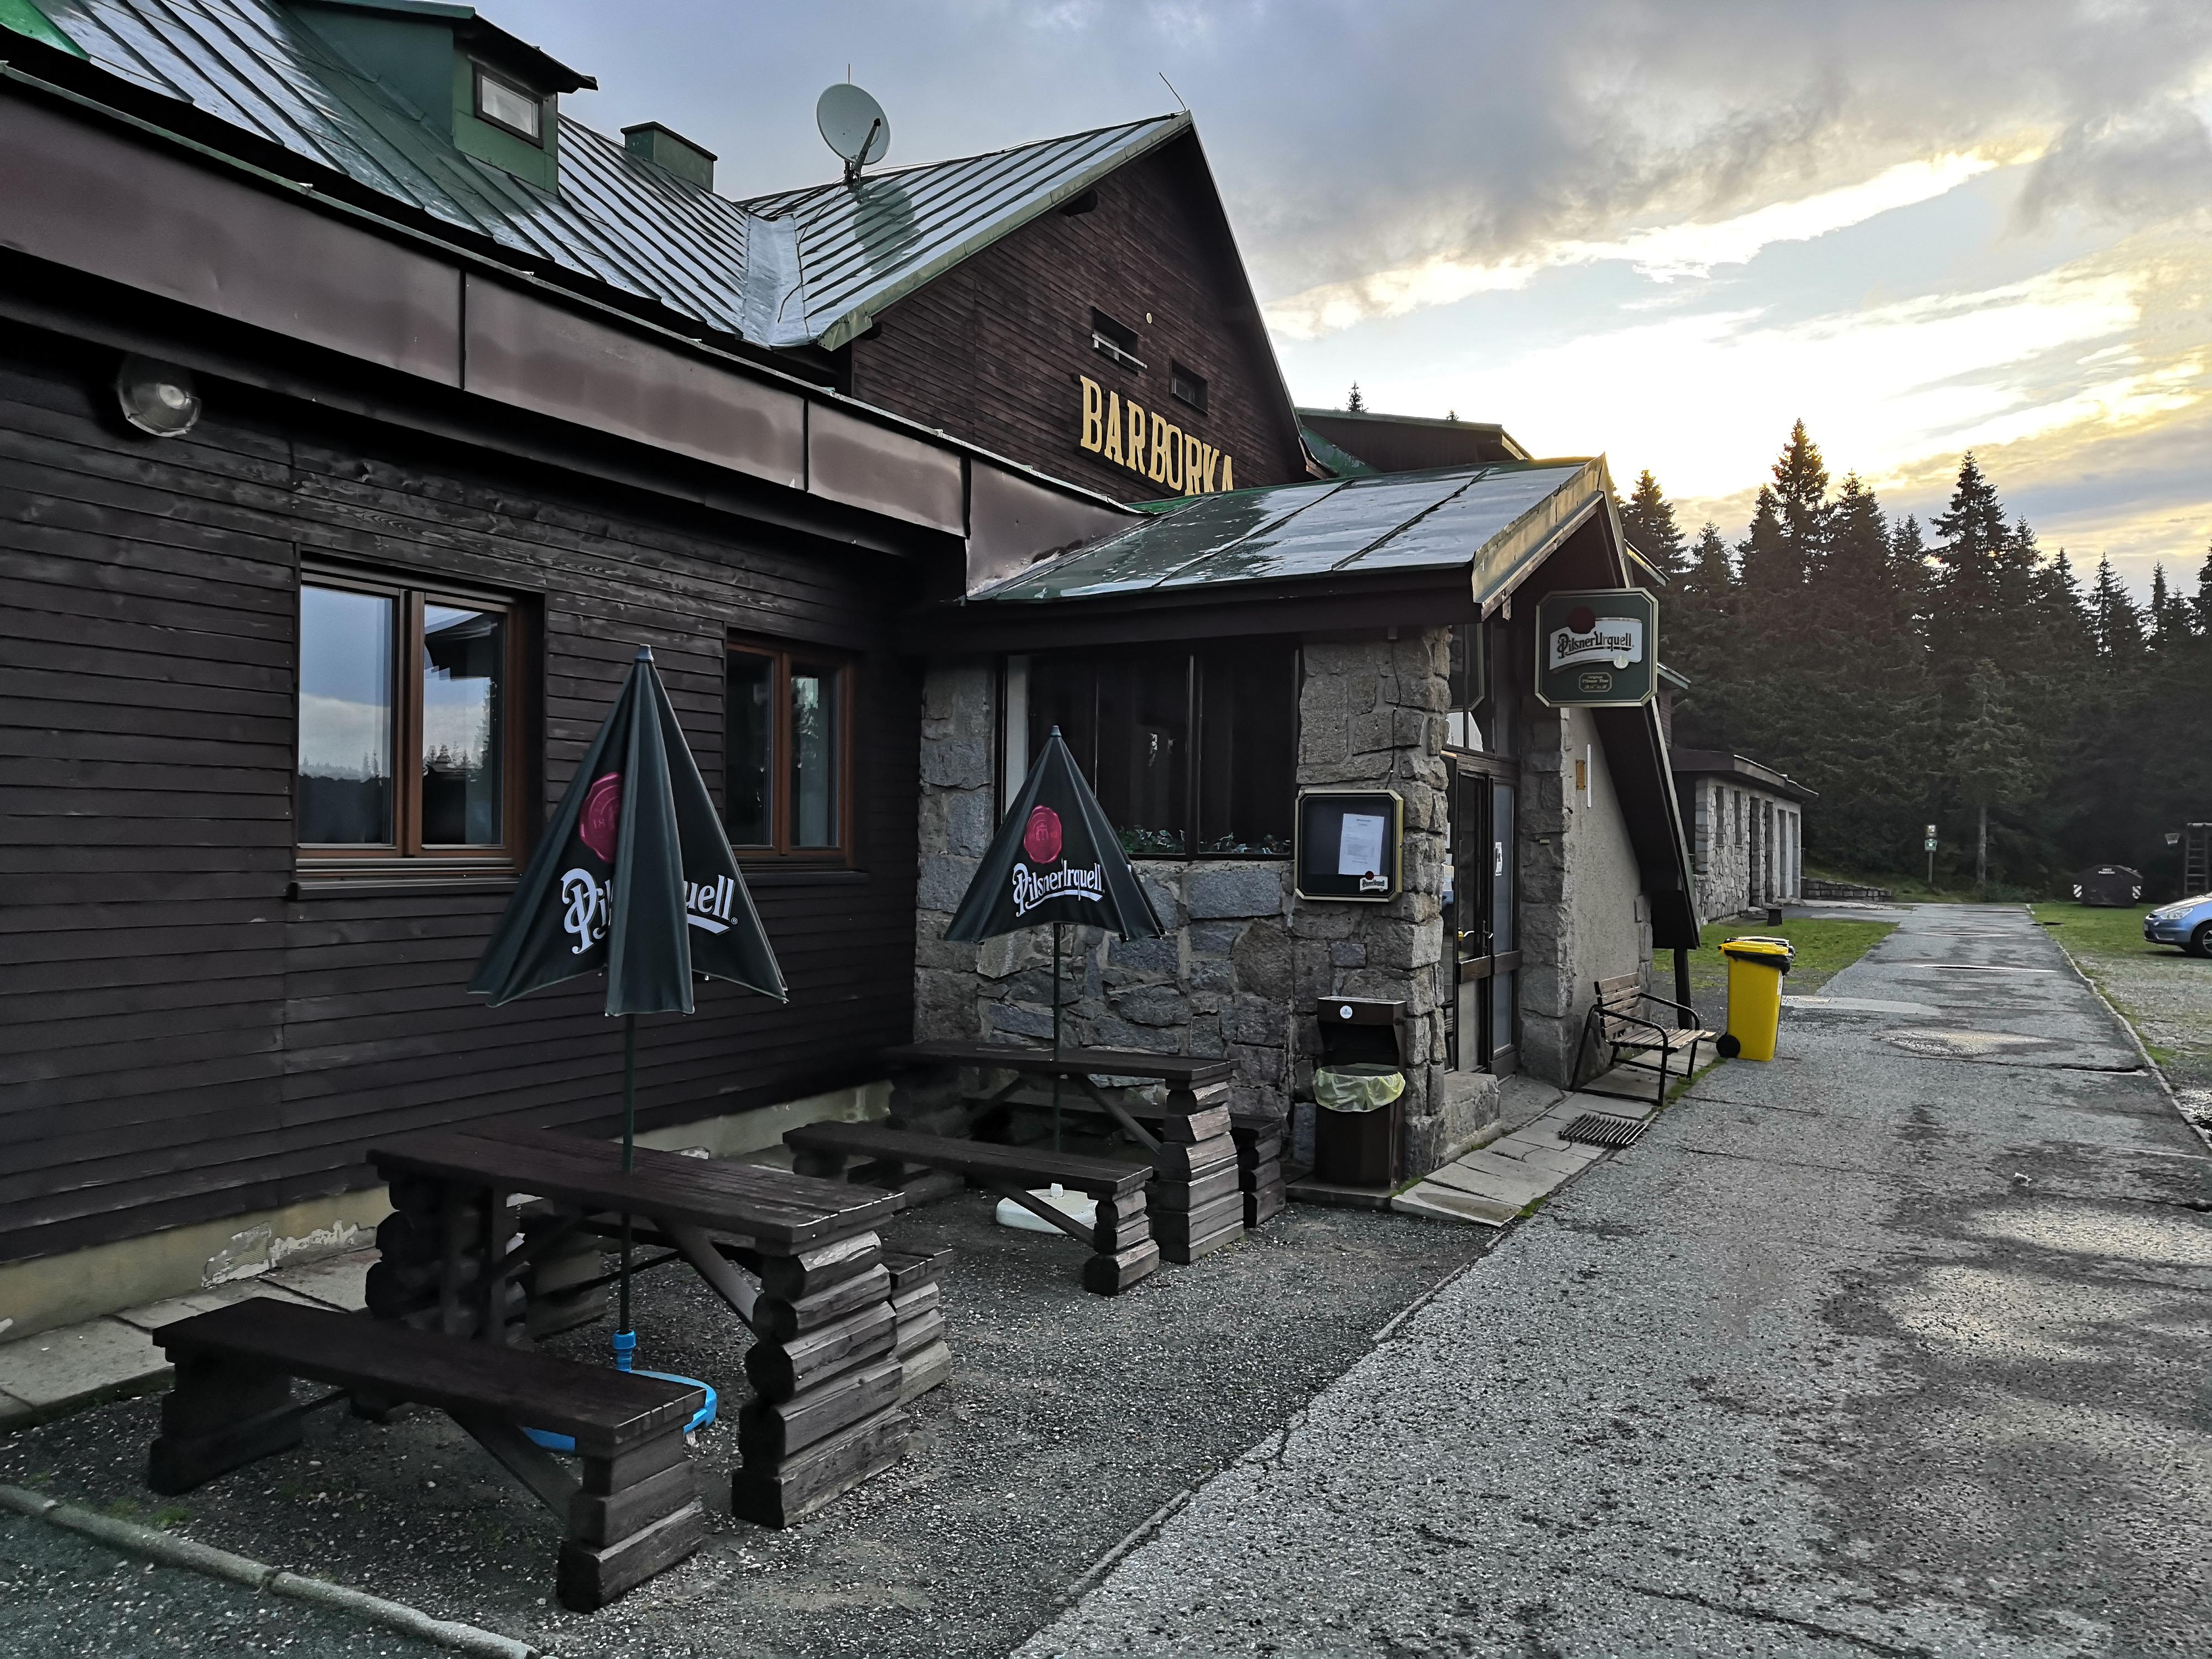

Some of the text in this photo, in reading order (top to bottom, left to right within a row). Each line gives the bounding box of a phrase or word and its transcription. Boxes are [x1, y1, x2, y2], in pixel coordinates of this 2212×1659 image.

[1080, 375, 1233, 496] BARBORKA
[1557, 630, 1631, 659] Pilsner Urquell
[684, 874, 734, 920] uell
[1012, 863, 1063, 917] Pilsner
